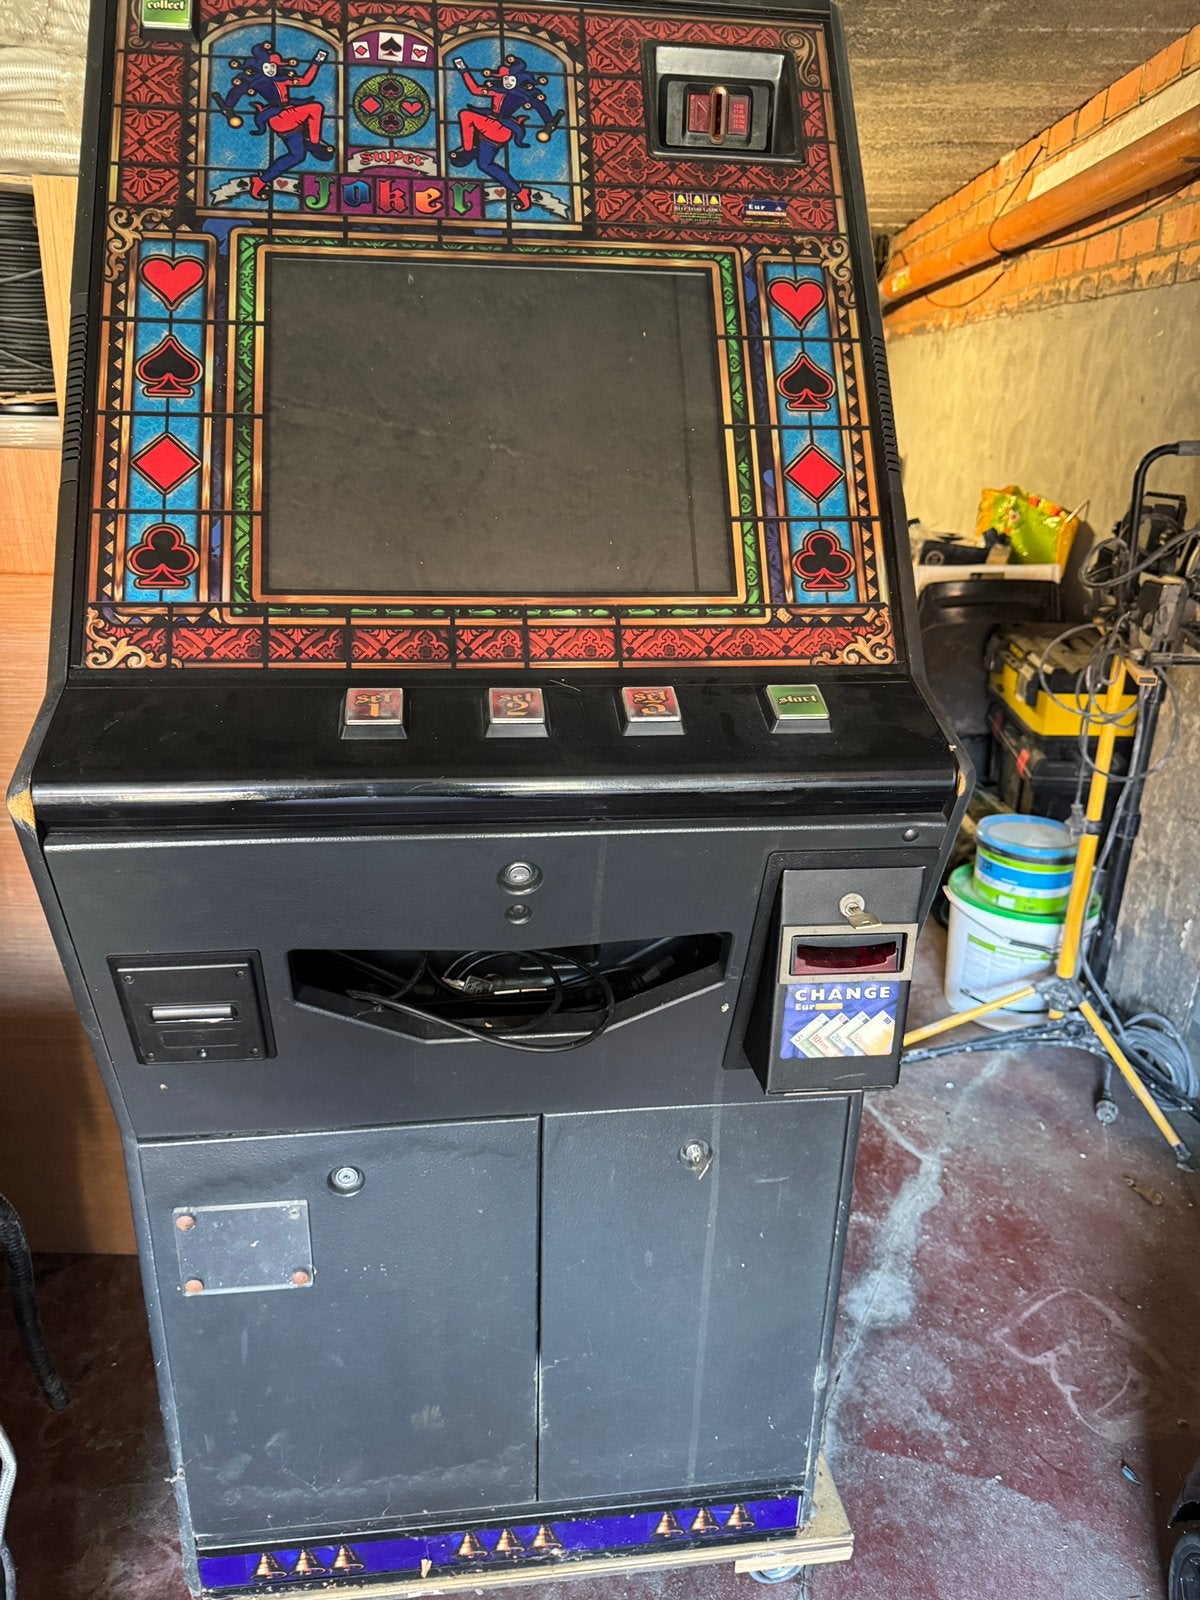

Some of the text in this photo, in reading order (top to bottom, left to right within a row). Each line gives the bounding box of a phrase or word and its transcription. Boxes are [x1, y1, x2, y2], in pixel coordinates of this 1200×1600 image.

[147, 0, 185, 9] collect
[360, 150, 428, 166] super
[305, 176, 477, 215] Joker
[506, 701, 529, 716] 2
[794, 986, 891, 1001] CHANGE
